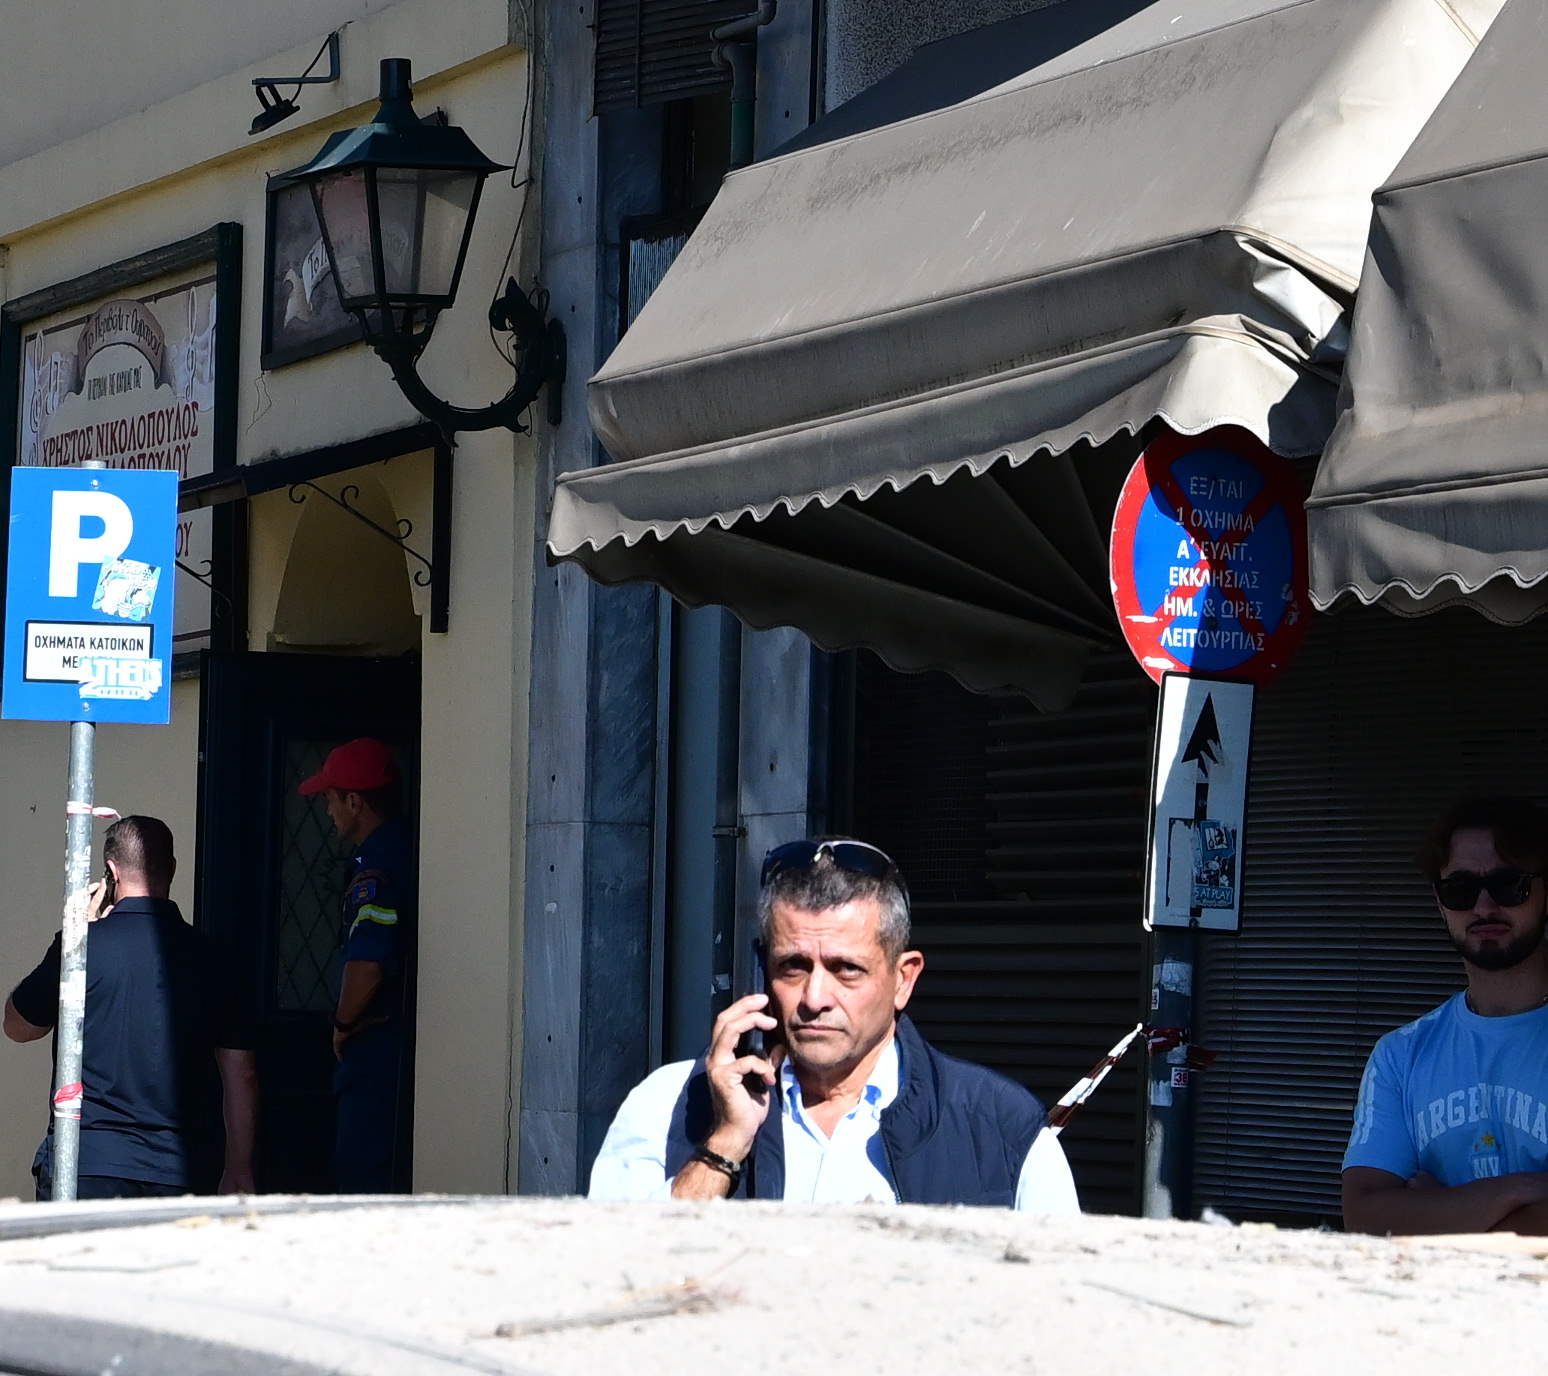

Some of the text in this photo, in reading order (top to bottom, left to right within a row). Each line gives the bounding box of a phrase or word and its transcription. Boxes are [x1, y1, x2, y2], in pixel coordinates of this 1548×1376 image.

[82, 330, 94, 357] Το
[42, 401, 200, 467] ΧΡΗΣΤΟΣ ΝΙΚΟΛΟΠΟΥΛΟΣ
[1189, 476, 1243, 500] ΕΞ/ΤΑΙ
[1176, 507, 1255, 532] 1 ΟΧΗΜΑ
[48, 490, 134, 598] P
[1169, 566, 1260, 589] ΕΚΚΛΗΣΙΑΣ
[1164, 595, 1264, 620] ΗΜ. & ΩΡΕΣ
[34, 635, 144, 652] ΟΧΗΜΑΤΑ ΚΑΤΟΙΚΩΝ
[1160, 627, 1266, 651] ΛΕΙΤΟΥΡΓΙΑΣ
[62, 656, 79, 669] ΜΕ
[1417, 1083, 1548, 1152] ARGENTINA
